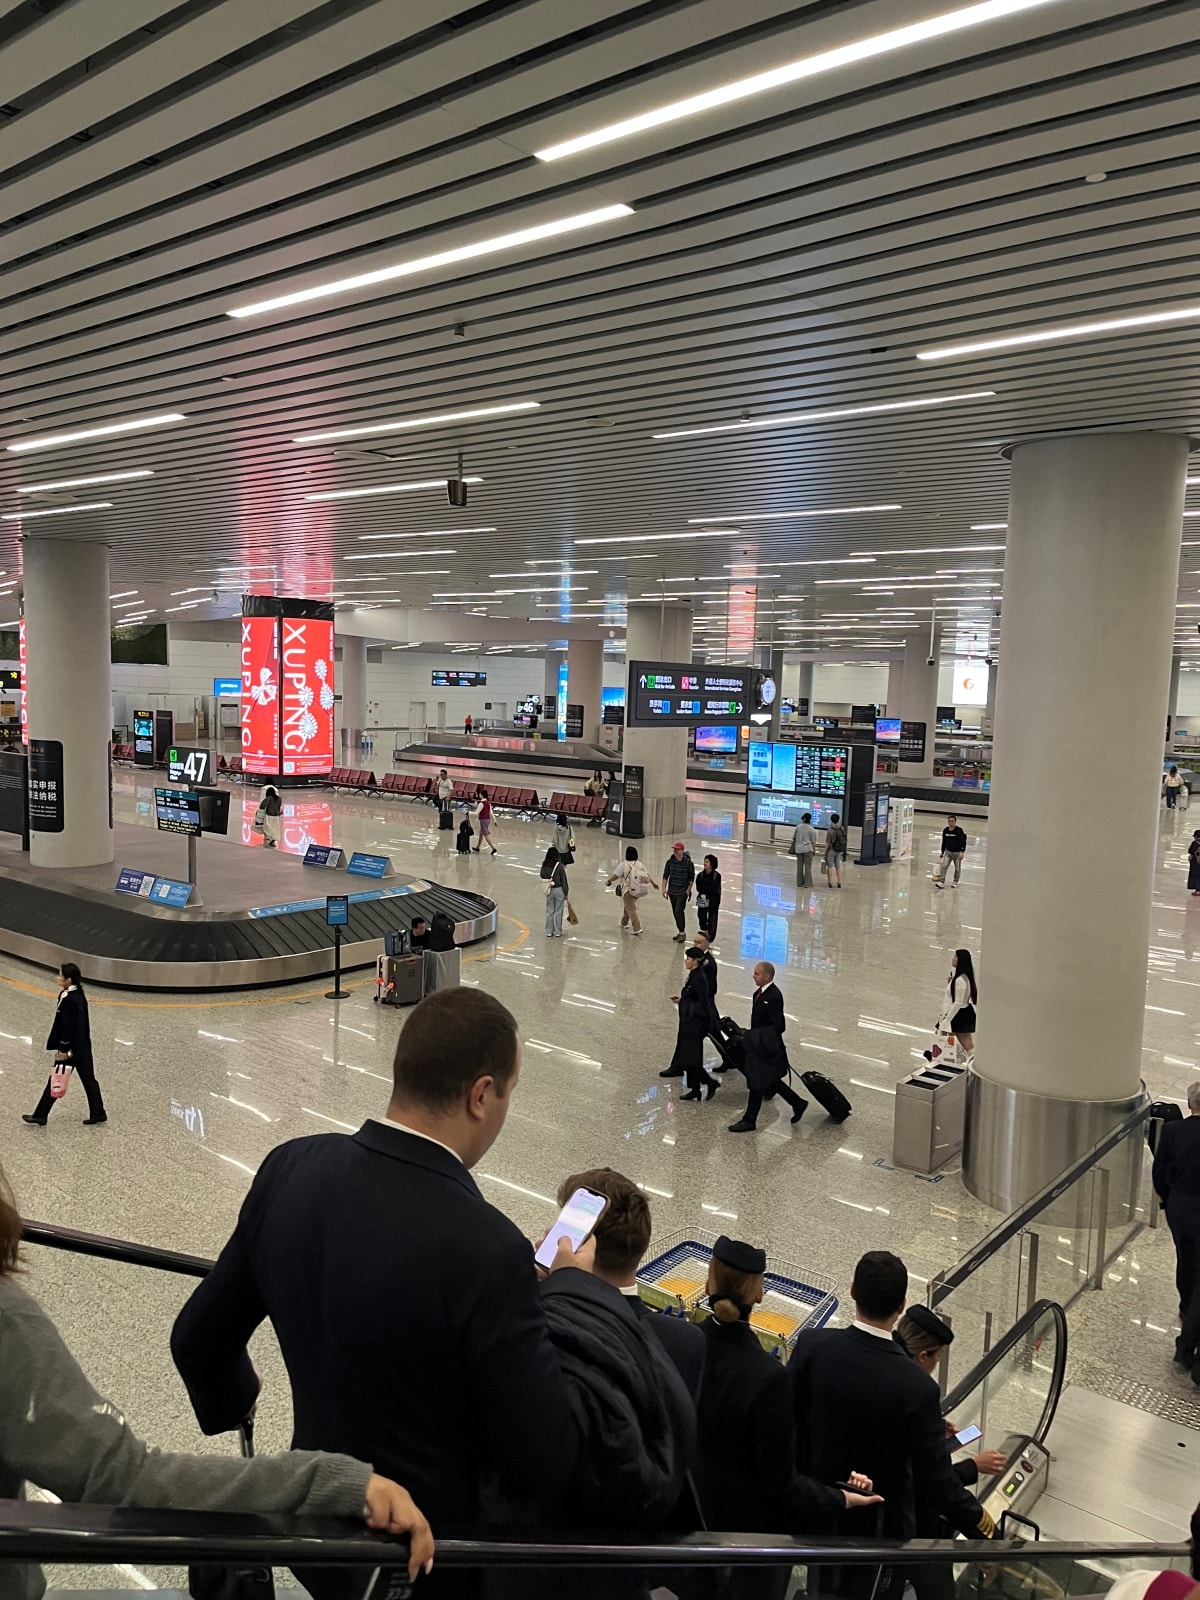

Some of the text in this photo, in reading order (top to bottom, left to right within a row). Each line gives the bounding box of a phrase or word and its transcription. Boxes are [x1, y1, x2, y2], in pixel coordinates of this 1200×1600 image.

[241, 622, 252, 747] XUPING
[284, 622, 307, 751] XUPING
[523, 702, 534, 713] 46
[183, 752, 208, 783] 47
